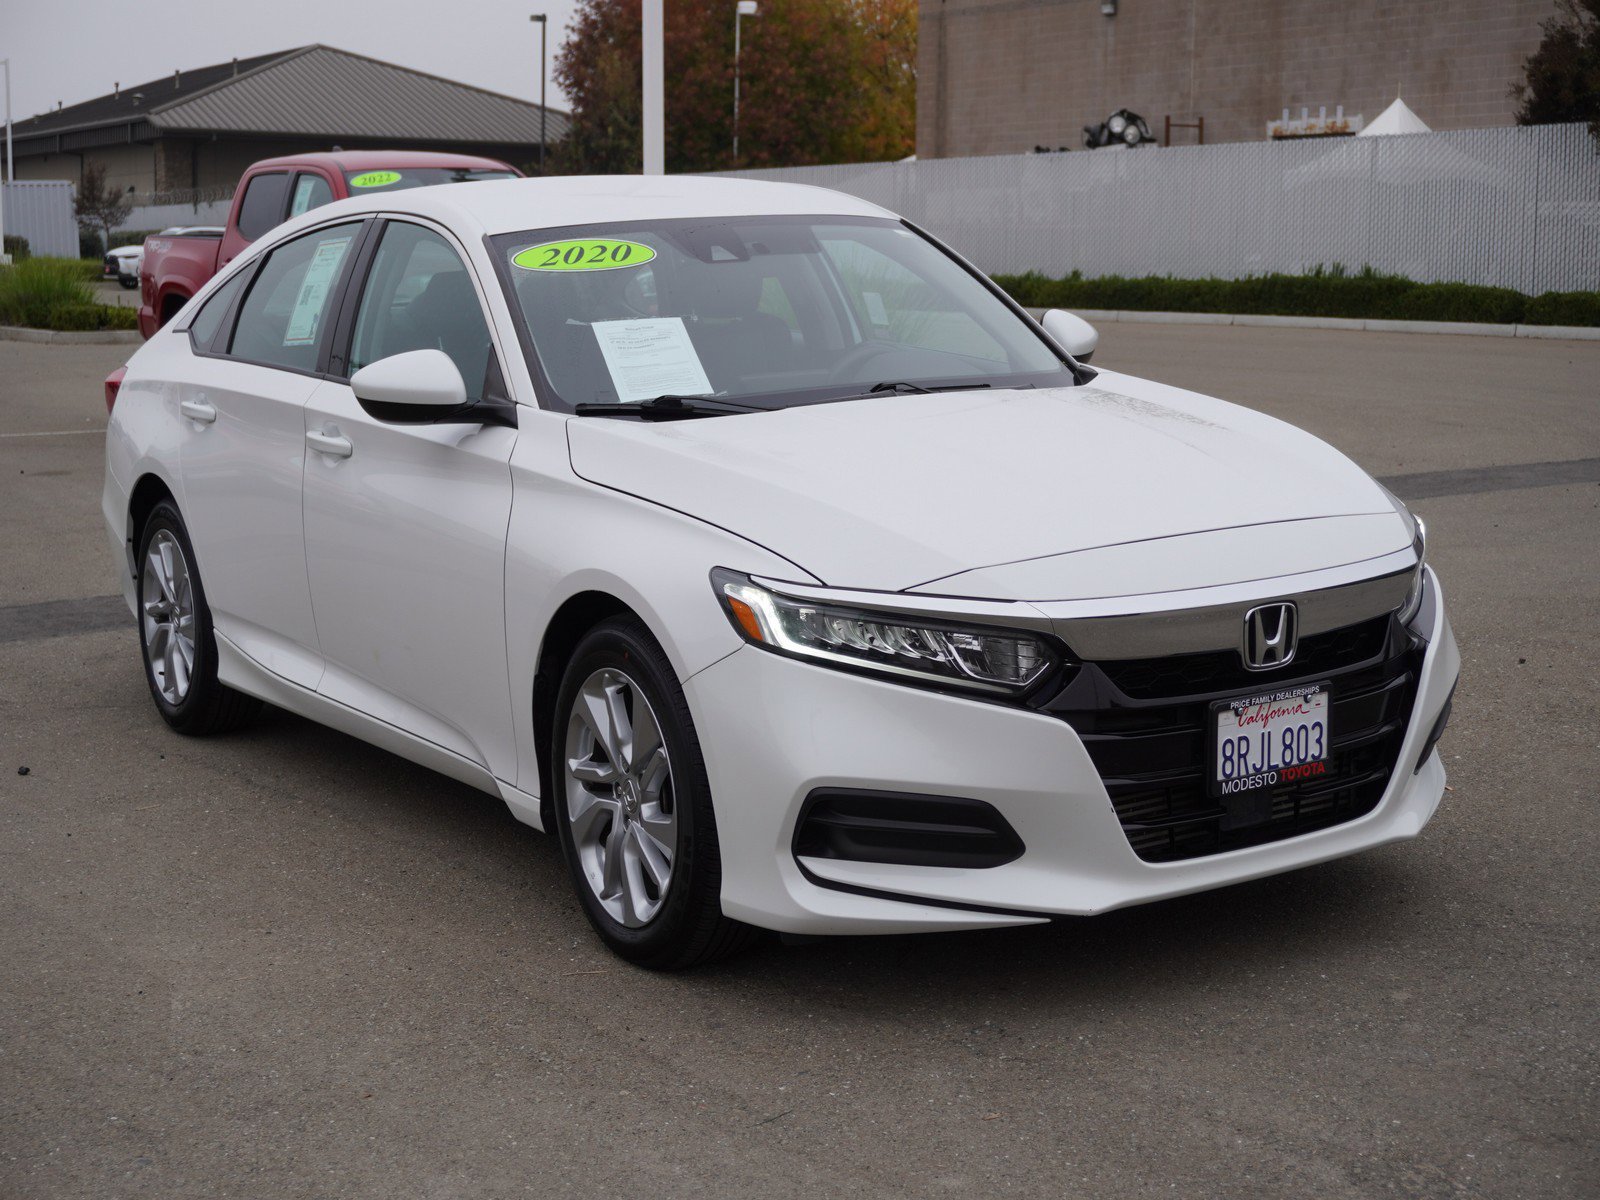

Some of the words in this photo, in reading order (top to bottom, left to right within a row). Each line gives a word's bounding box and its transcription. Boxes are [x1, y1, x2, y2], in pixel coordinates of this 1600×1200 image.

[361, 173, 392, 186] 2022
[539, 244, 632, 267] 2020
[1230, 699, 1250, 709] PRICE
[1251, 695, 1275, 705] FAMILY
[1276, 686, 1320, 700] DEALERSHIPS
[1238, 703, 1310, 728] California
[1222, 721, 1324, 779] 8RJL803
[1222, 771, 1278, 795] MODESTO
[1280, 761, 1326, 782] TOYOTA
